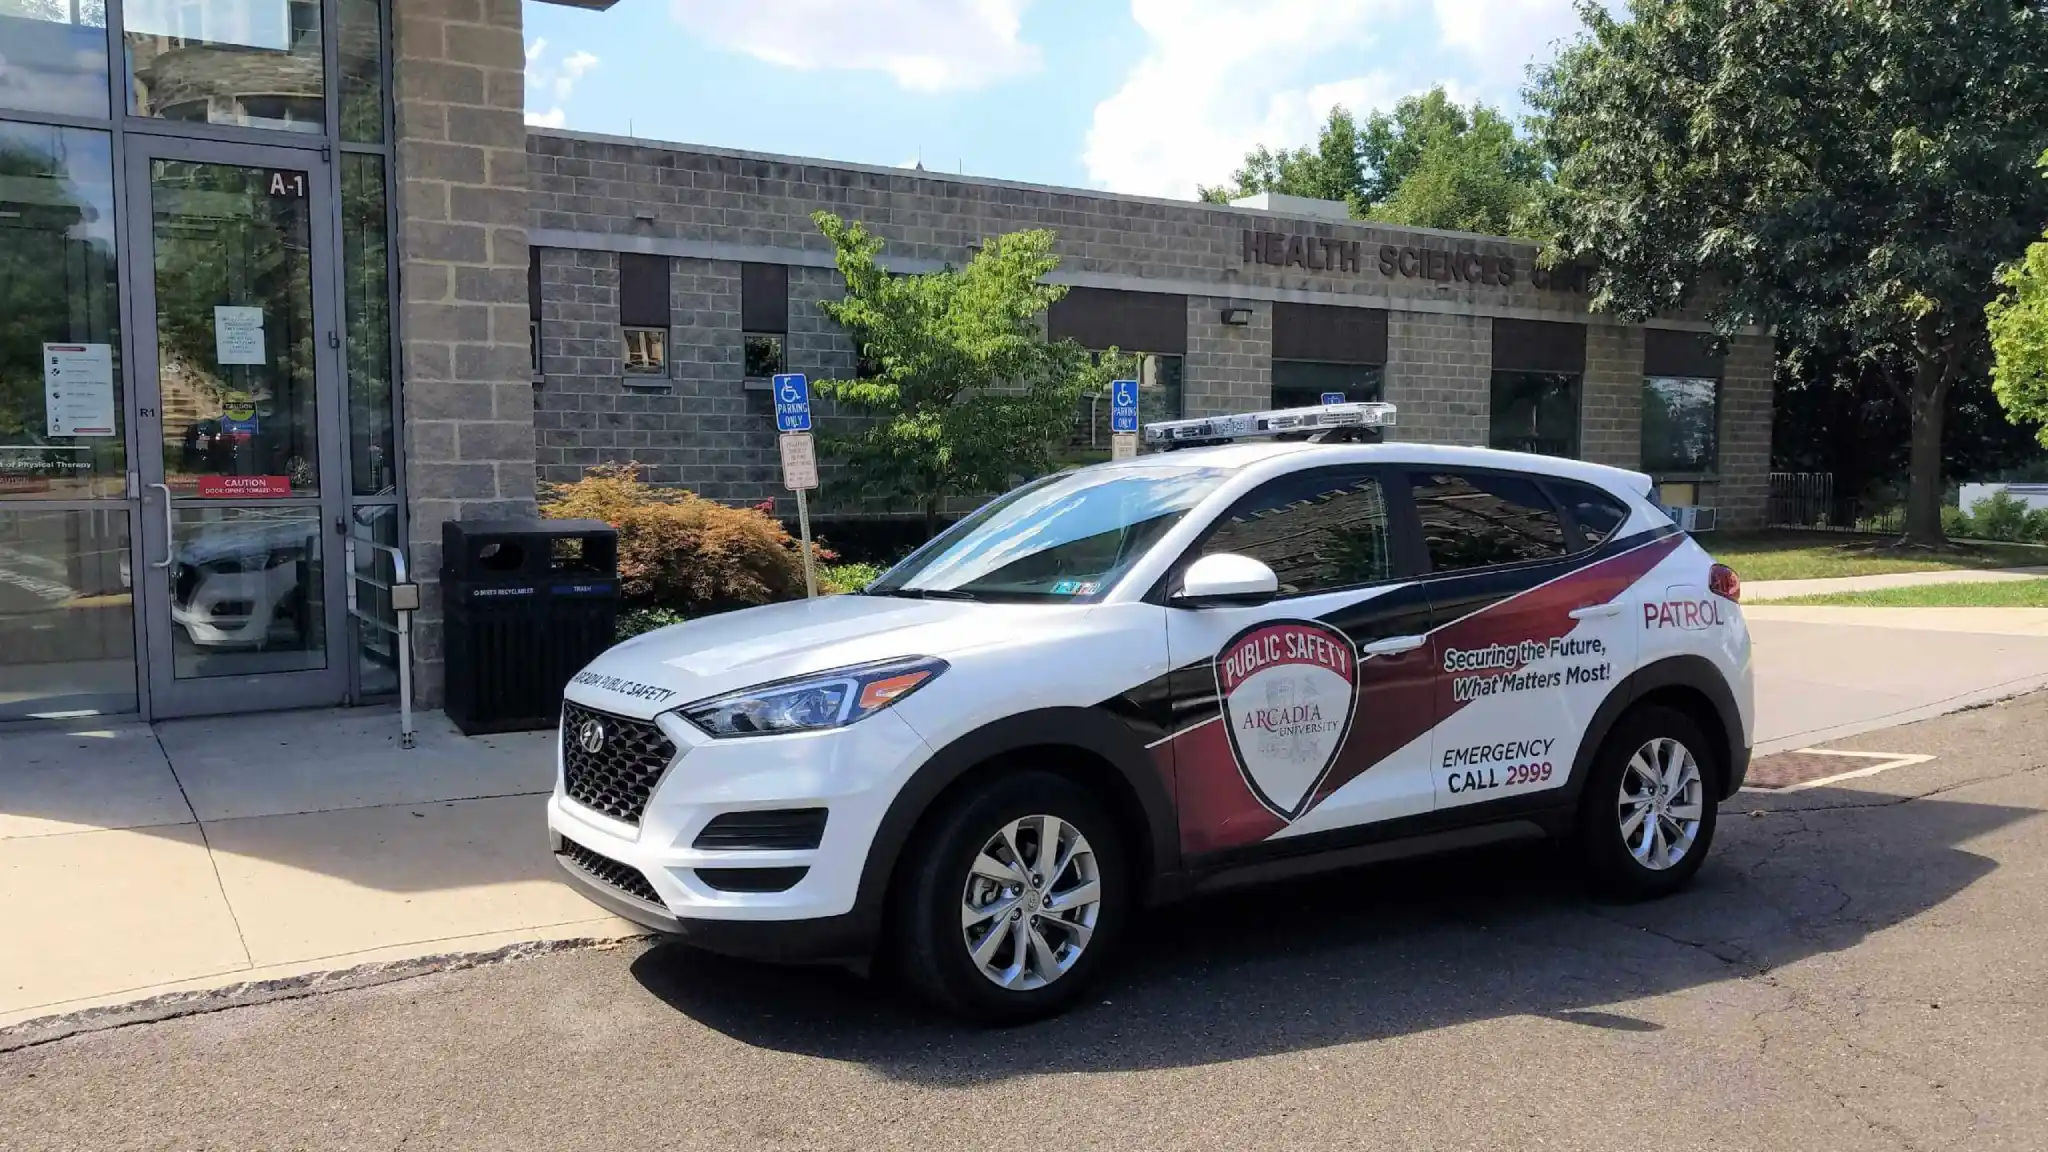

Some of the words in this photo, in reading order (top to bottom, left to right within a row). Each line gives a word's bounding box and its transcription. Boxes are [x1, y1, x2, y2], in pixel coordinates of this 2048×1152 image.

[270, 173, 303, 197] A-1
[1243, 229, 1361, 273] HEALTH
[1378, 244, 1515, 287] SCIENCES
[140, 408, 155, 418] R1
[778, 402, 808, 414] PARKING
[1113, 407, 1137, 416] PARKING
[785, 416, 803, 427] ONLY
[1117, 418, 1133, 428] ONLY
[18, 461, 54, 469] Physical
[56, 461, 92, 469] Therapy
[224, 479, 267, 487] CAUTION
[1643, 600, 1724, 630] PATROL
[1225, 633, 1281, 688] PUBLIC
[1285, 632, 1347, 674] SAFETY
[1444, 643, 1517, 672] Securing
[1519, 640, 1545, 663] the
[1550, 637, 1606, 658] Future,
[600, 675, 634, 694] PUBLIC
[627, 683, 677, 702] SAFETY
[1454, 675, 1500, 700] What
[1501, 671, 1561, 693] Matters
[1566, 663, 1611, 685] Most!
[1242, 703, 1322, 733] ARCADIA
[1279, 720, 1339, 737] UNIVERSITY
[1442, 738, 1555, 768] EMERGENCY
[1448, 767, 1500, 794] CALL
[1505, 761, 1553, 786] 2999
